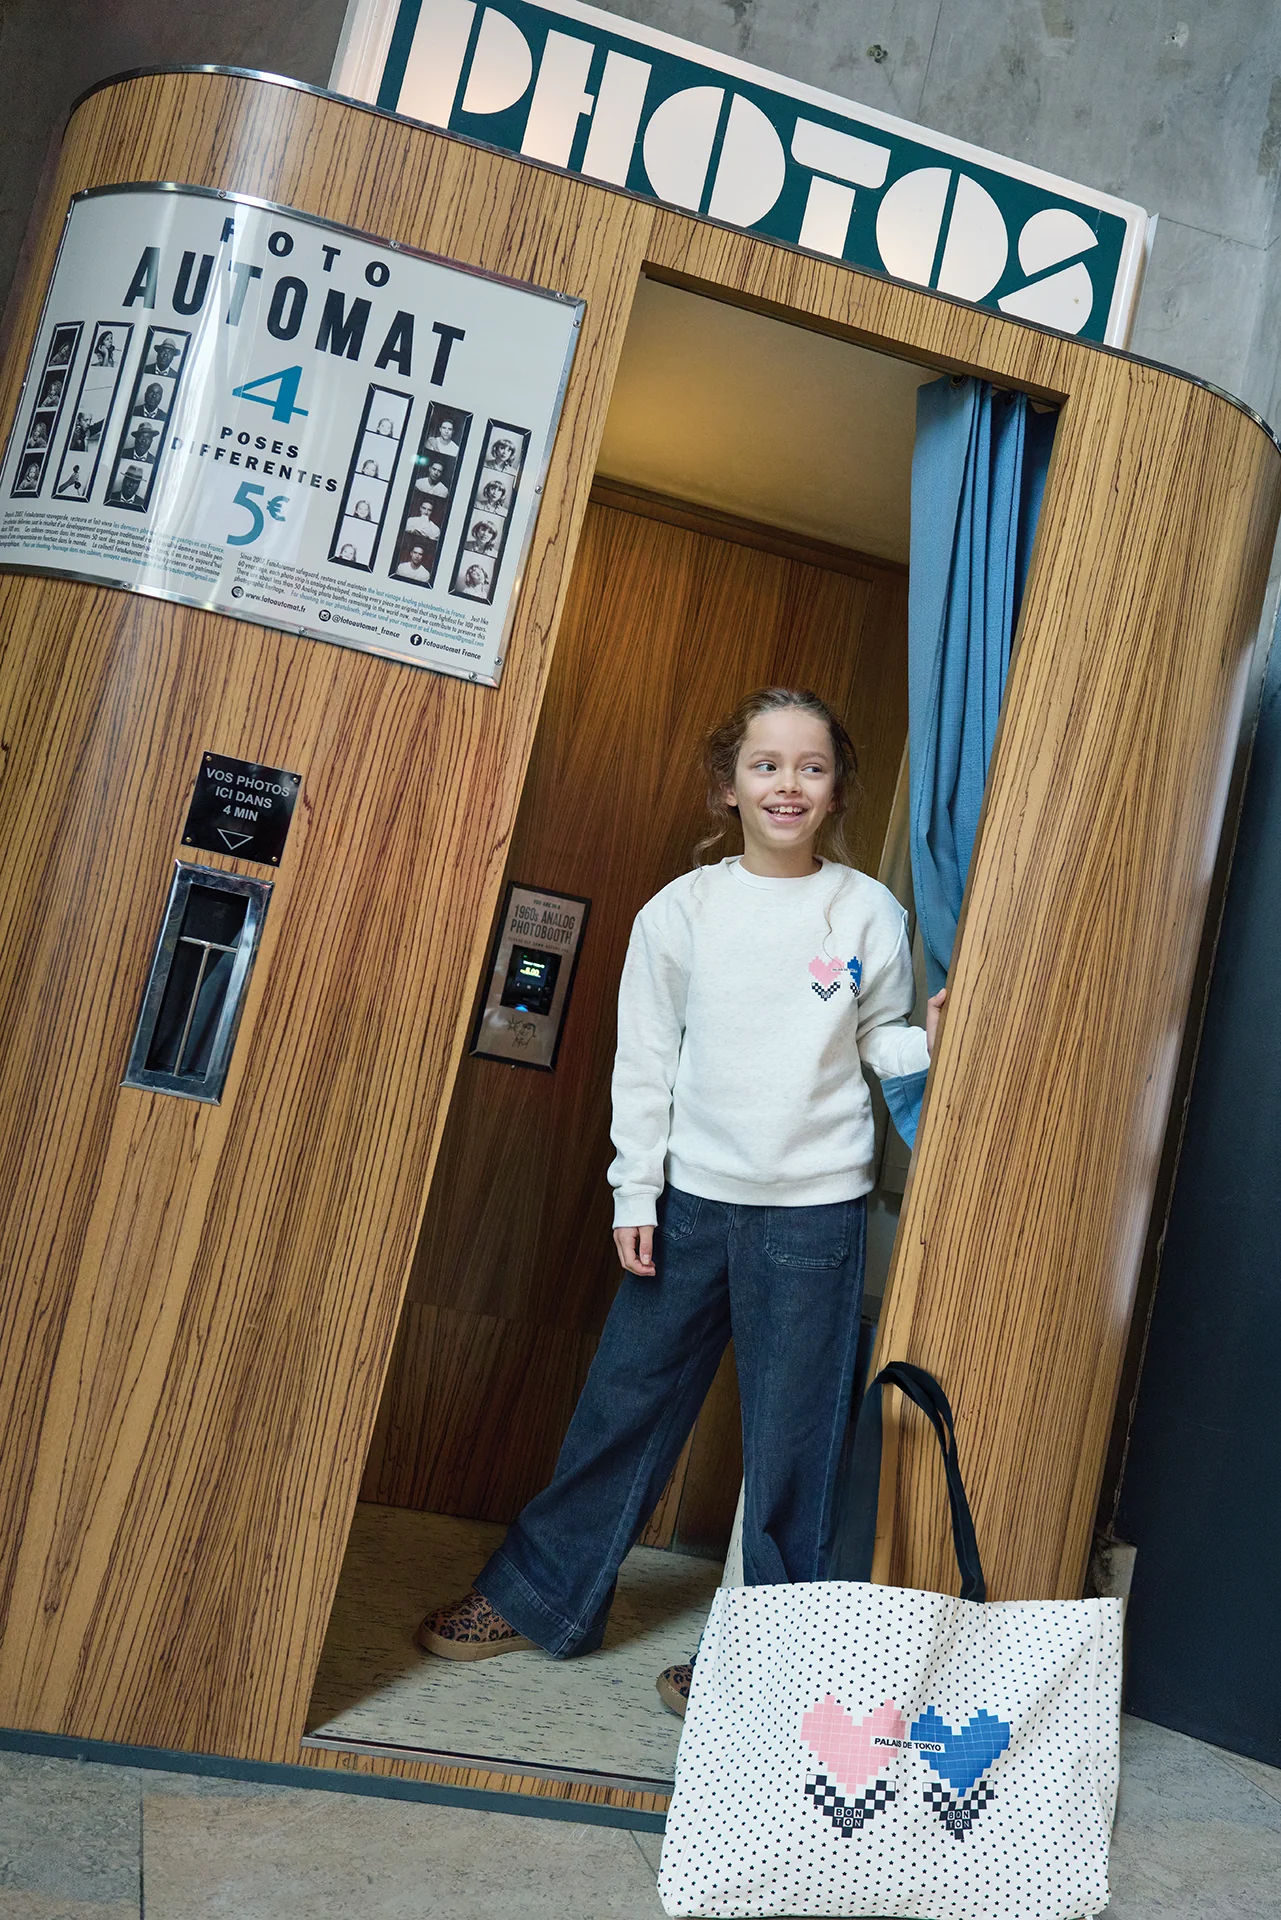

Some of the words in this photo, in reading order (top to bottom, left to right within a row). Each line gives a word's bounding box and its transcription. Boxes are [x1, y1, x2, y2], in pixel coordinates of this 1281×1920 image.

[395, 0, 1099, 338] PHOTOS
[122, 246, 466, 386] AUTOMAT
[232, 365, 309, 424] 4
[220, 427, 298, 458] POSES
[171, 437, 337, 492] DIFFERENTES
[226, 481, 290, 546] 5€
[245, 593, 305, 612] www.fotoautomat.fr
[332, 614, 400, 638] @fotoautomat_france
[423, 638, 461, 654] Fotoautomat
[461, 648, 481, 659] France
[207, 768, 233, 783] VOS
[236, 775, 290, 796] PHOTOS
[215, 786, 233, 799] ICI
[236, 791, 272, 808] DANS
[223, 805, 231, 815] 4
[234, 807, 258, 821] MIN
[515, 904, 539, 922] 1960s
[541, 911, 575, 929] ANALOG
[510, 919, 572, 944] PHOTOBOOTH
[875, 1737, 901, 1748] PALAIS
[902, 1740, 912, 1749] DE
[914, 1742, 942, 1751] TOKYO
[835, 1818, 861, 1827] TON
[836, 1808, 862, 1817] BON
[948, 1810, 969, 1819] BON
[948, 1820, 970, 1829] TON
